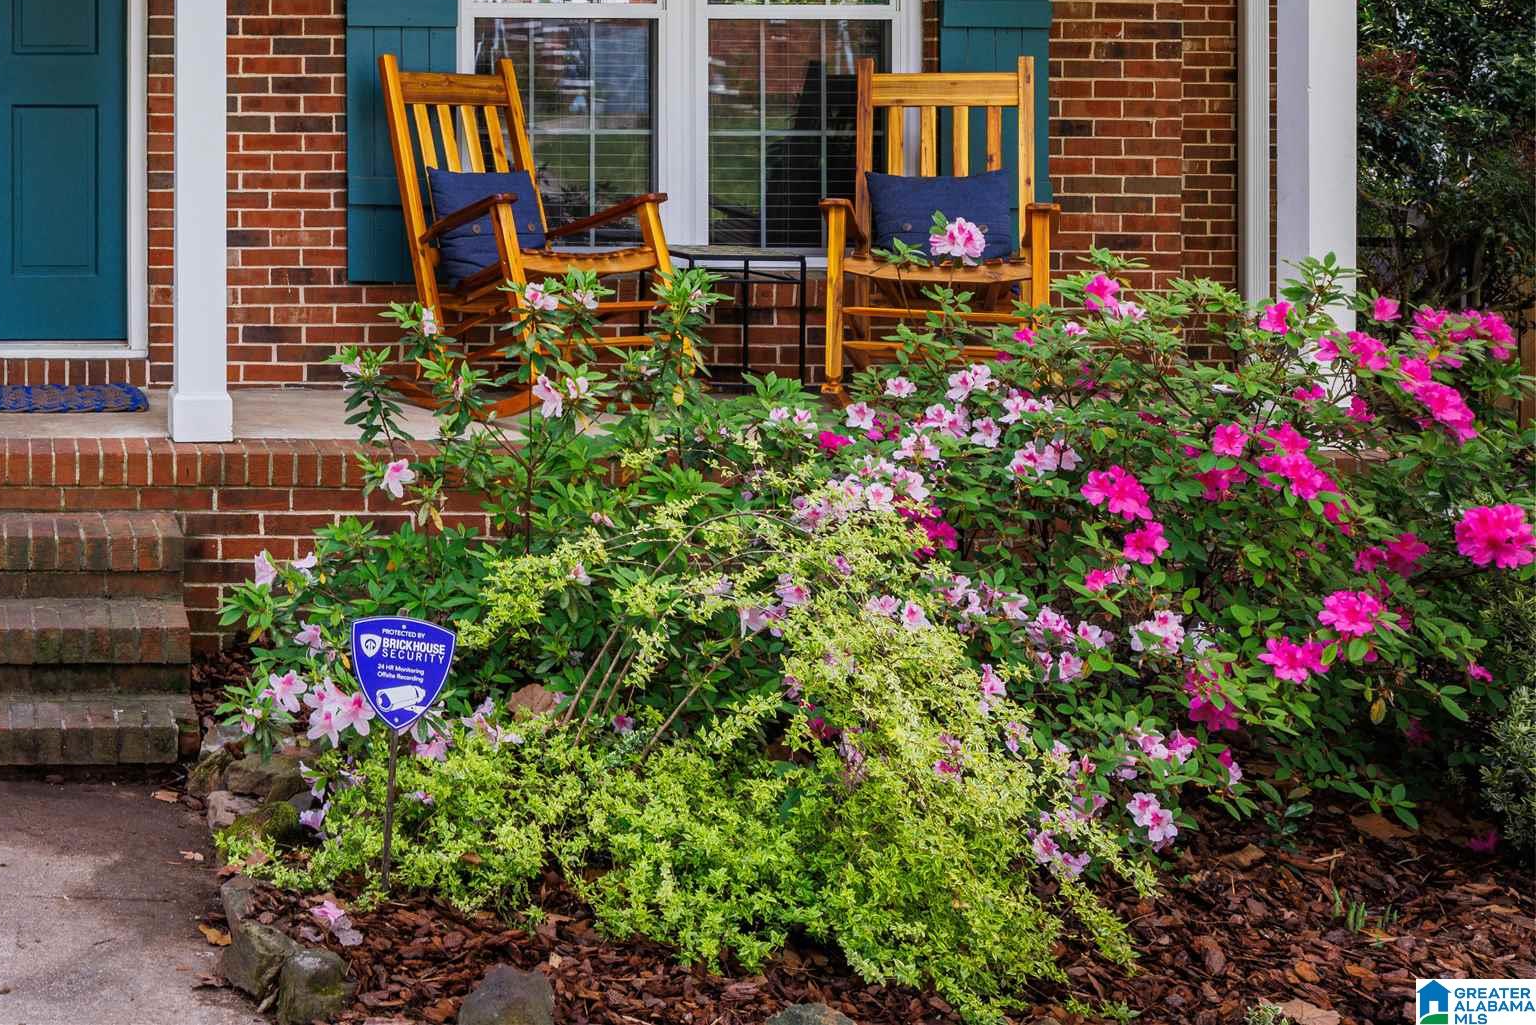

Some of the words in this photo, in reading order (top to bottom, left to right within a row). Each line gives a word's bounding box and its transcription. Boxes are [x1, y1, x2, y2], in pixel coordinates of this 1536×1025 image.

[382, 628, 417, 638] PROTECTED
[382, 637, 446, 655] BRICKHOUSE
[382, 648, 445, 664] SECURITY
[395, 665, 425, 676] Monitoring
[396, 673, 424, 683] Recording
